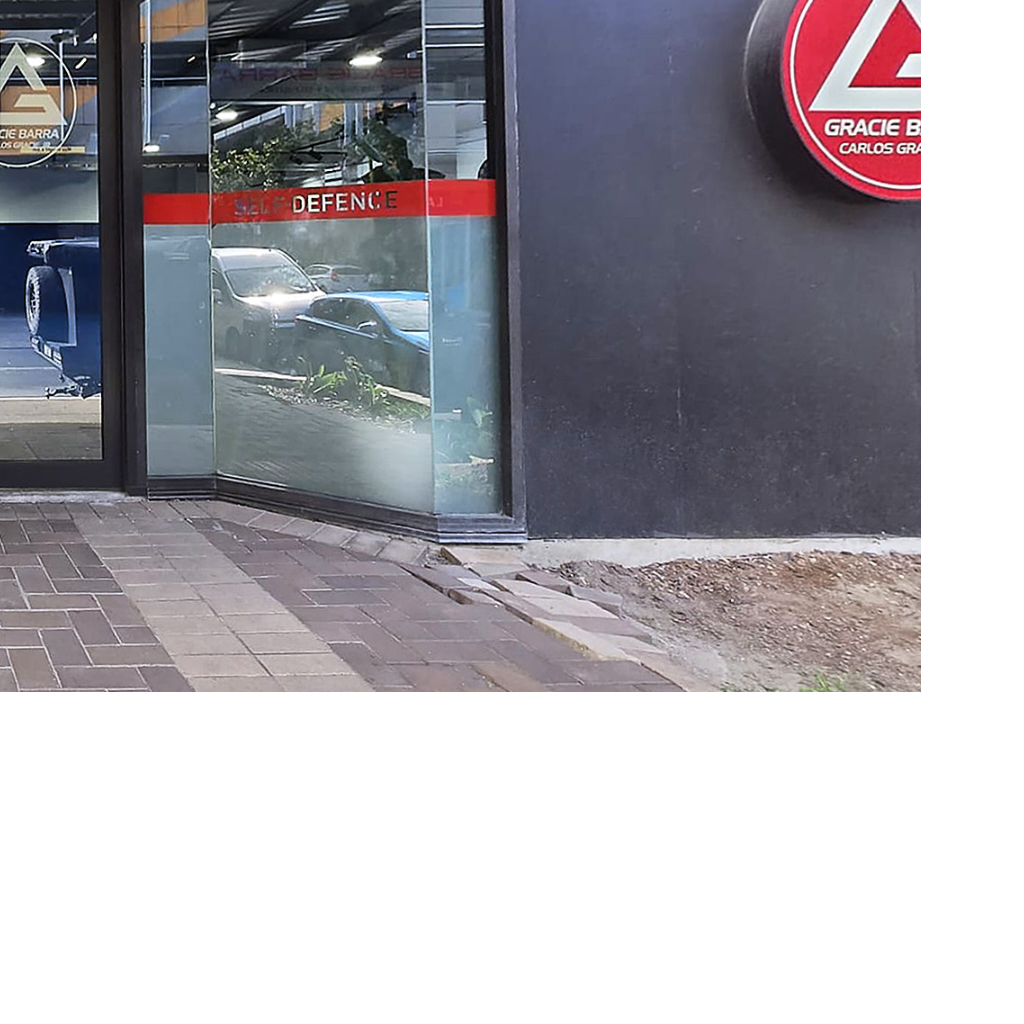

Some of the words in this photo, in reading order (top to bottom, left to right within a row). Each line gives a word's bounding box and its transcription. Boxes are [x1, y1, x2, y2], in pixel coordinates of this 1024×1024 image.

[824, 118, 901, 136] GRACIE
[18, 128, 59, 139] BARRA
[839, 142, 894, 154] CARLOS
